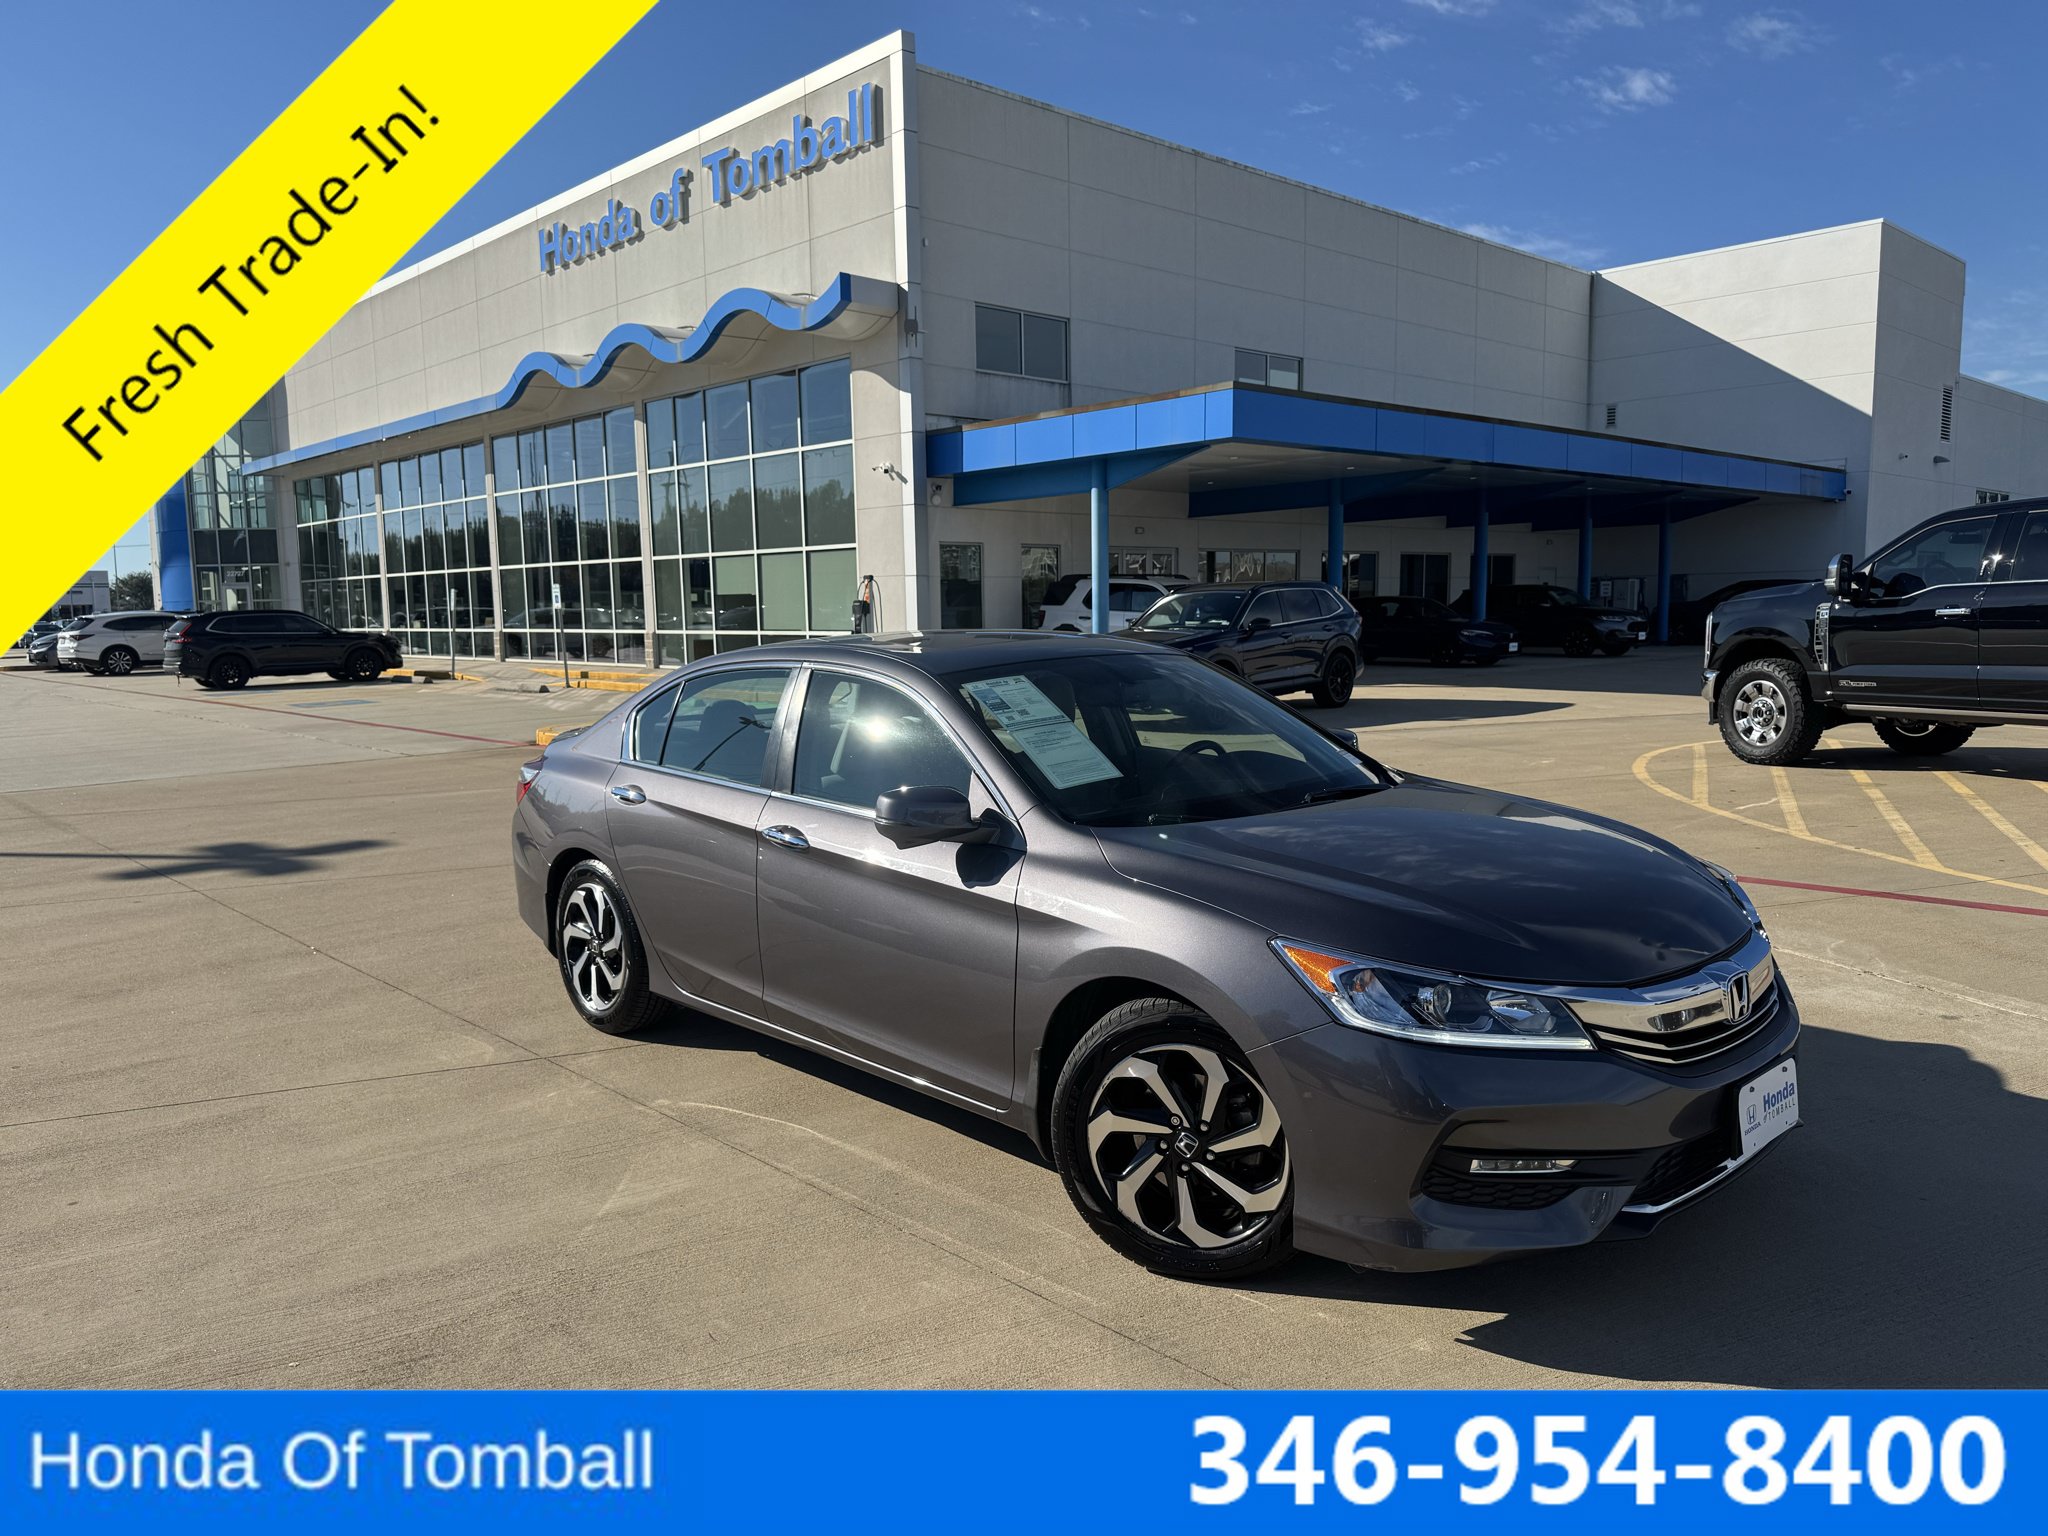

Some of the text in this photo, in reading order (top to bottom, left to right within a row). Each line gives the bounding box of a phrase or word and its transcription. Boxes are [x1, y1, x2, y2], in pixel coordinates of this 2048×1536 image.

[539, 82, 875, 272] Honda of Tomball
[1763, 1081, 1795, 1112] Honda
[1767, 1098, 1796, 1121] TOMBALL
